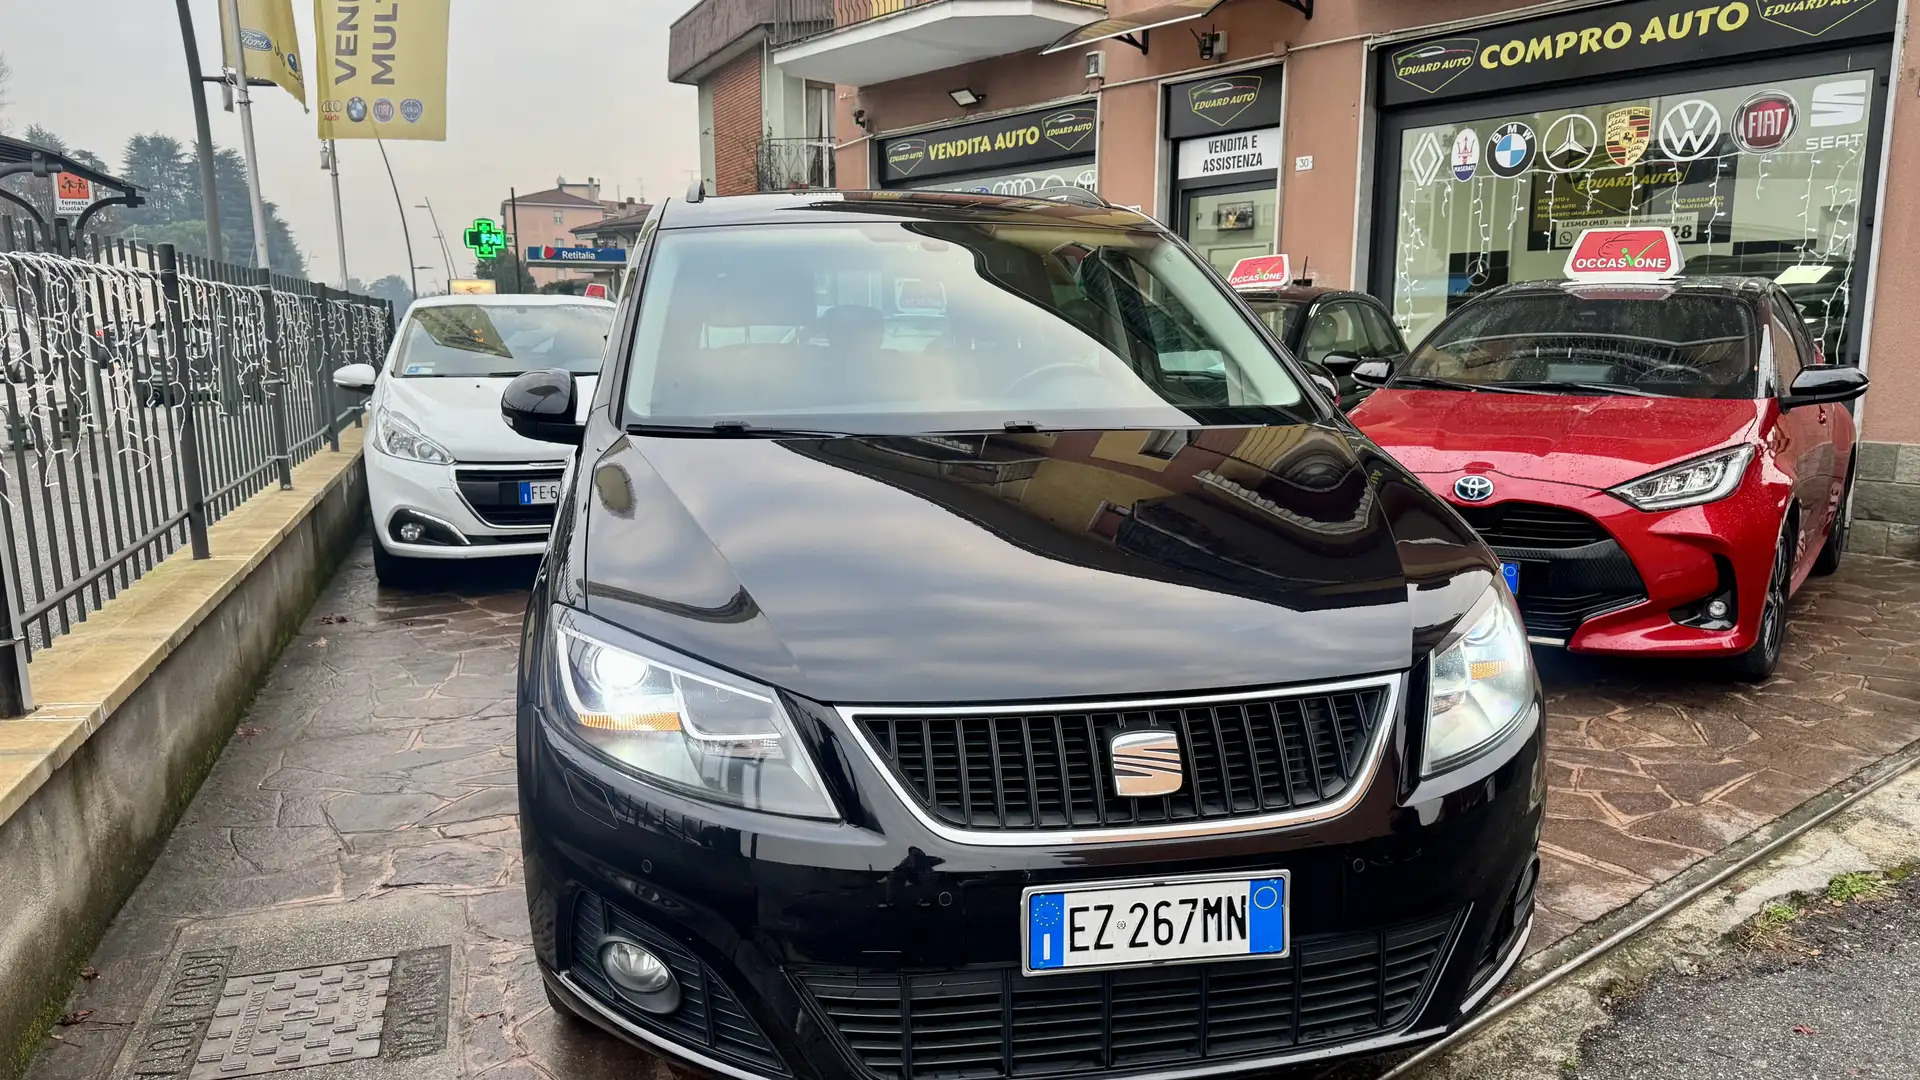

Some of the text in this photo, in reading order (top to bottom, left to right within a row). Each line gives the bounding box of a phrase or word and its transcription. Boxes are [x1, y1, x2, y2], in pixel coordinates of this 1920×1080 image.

[334, 0, 360, 85] VEN
[370, 0, 398, 85] MUL
[1479, 1, 1750, 70] COMPRO AUTO
[1398, 56, 1472, 77] EDUARD AUTO
[1193, 92, 1256, 111] EDUARD AUTO
[1607, 107, 1652, 121] PORSCHE
[1747, 107, 1787, 139] FIAT
[1046, 122, 1093, 137] EDUARD AUTO
[1491, 124, 1533, 144] BMW
[928, 126, 1040, 161] VENDITA AUTO
[1208, 134, 1258, 154] VENDITA E
[1805, 133, 1865, 150] SEAT
[889, 151, 923, 164] EDUARD AUTO
[1202, 152, 1263, 173] ASSISTENZA
[1298, 158, 1310, 169] 30
[1577, 171, 1683, 190] EDUARD AUTO
[1561, 220, 1588, 228] LESMO
[561, 250, 596, 260] Retitalia
[531, 485, 547, 500] FE
[1069, 903, 1115, 952] EZ
[1128, 895, 1247, 949] 267MN
